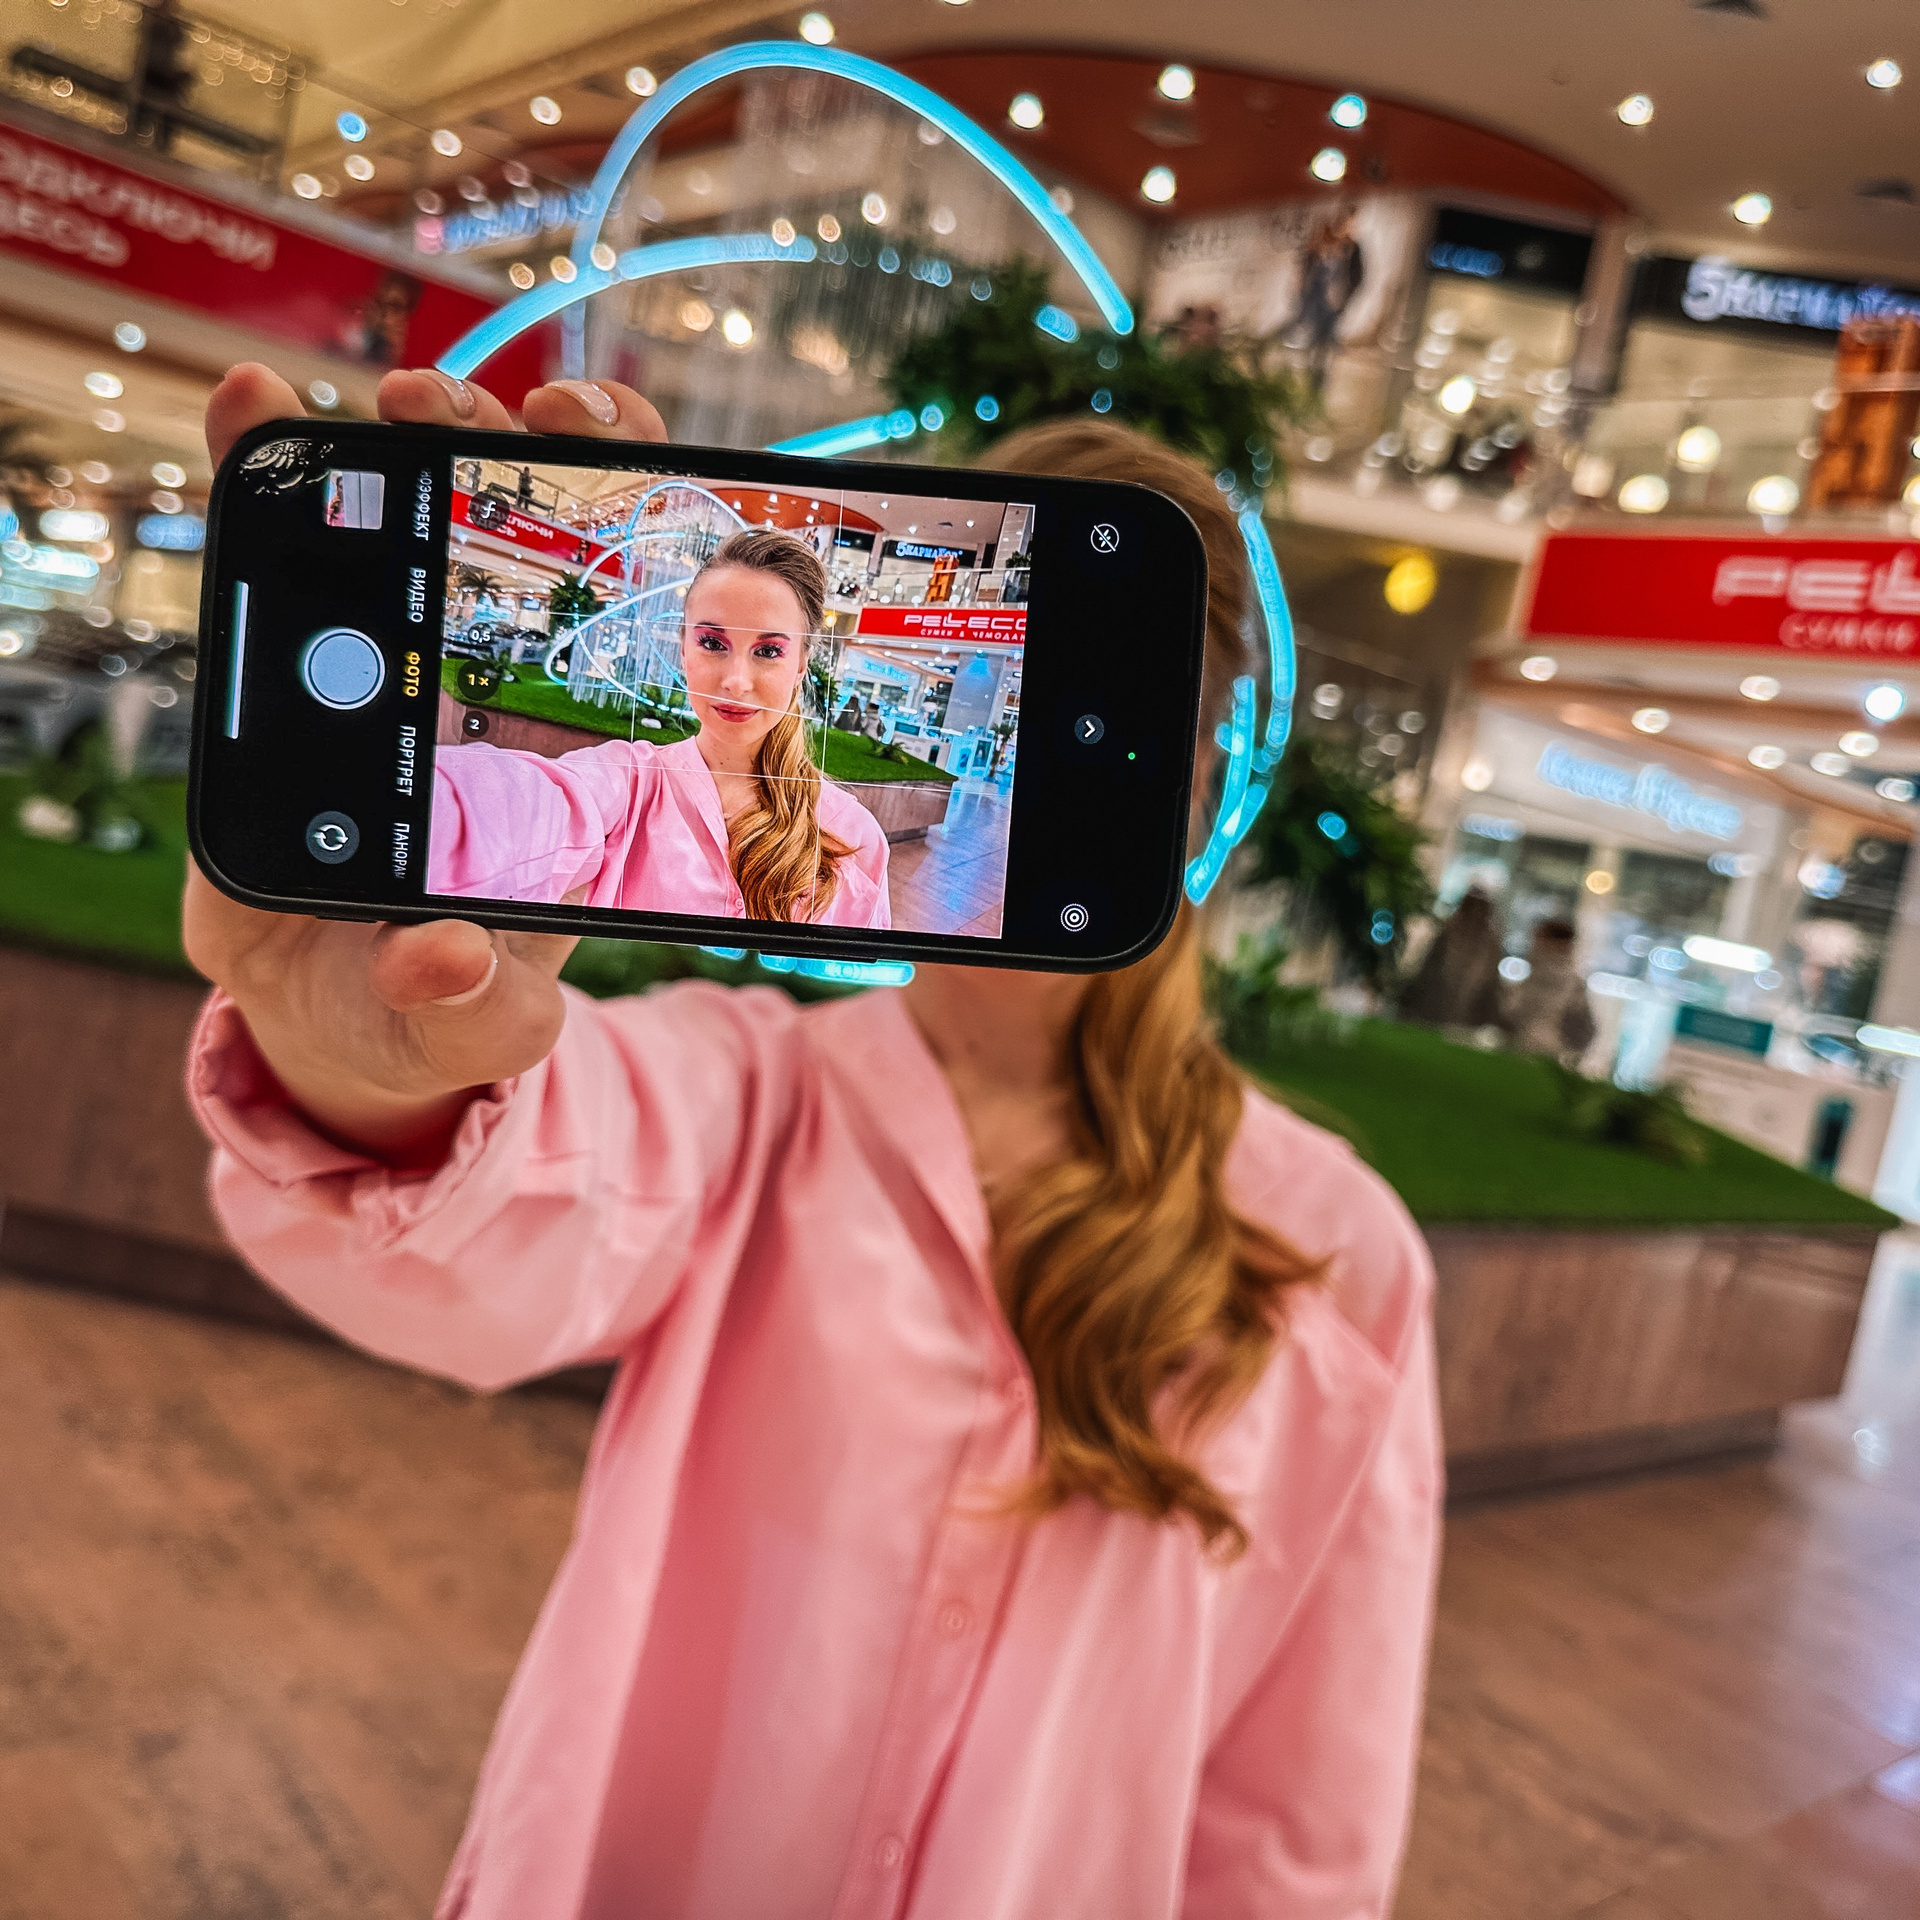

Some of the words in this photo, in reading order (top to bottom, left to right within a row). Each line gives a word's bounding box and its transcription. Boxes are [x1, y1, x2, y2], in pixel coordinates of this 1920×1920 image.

[409, 568, 426, 623] ВИДЕО
[472, 630, 491, 643] 0,5
[405, 651, 421, 697] ФОТО
[470, 719, 480, 730] 2
[398, 724, 416, 796] ПОРТРЕТ
